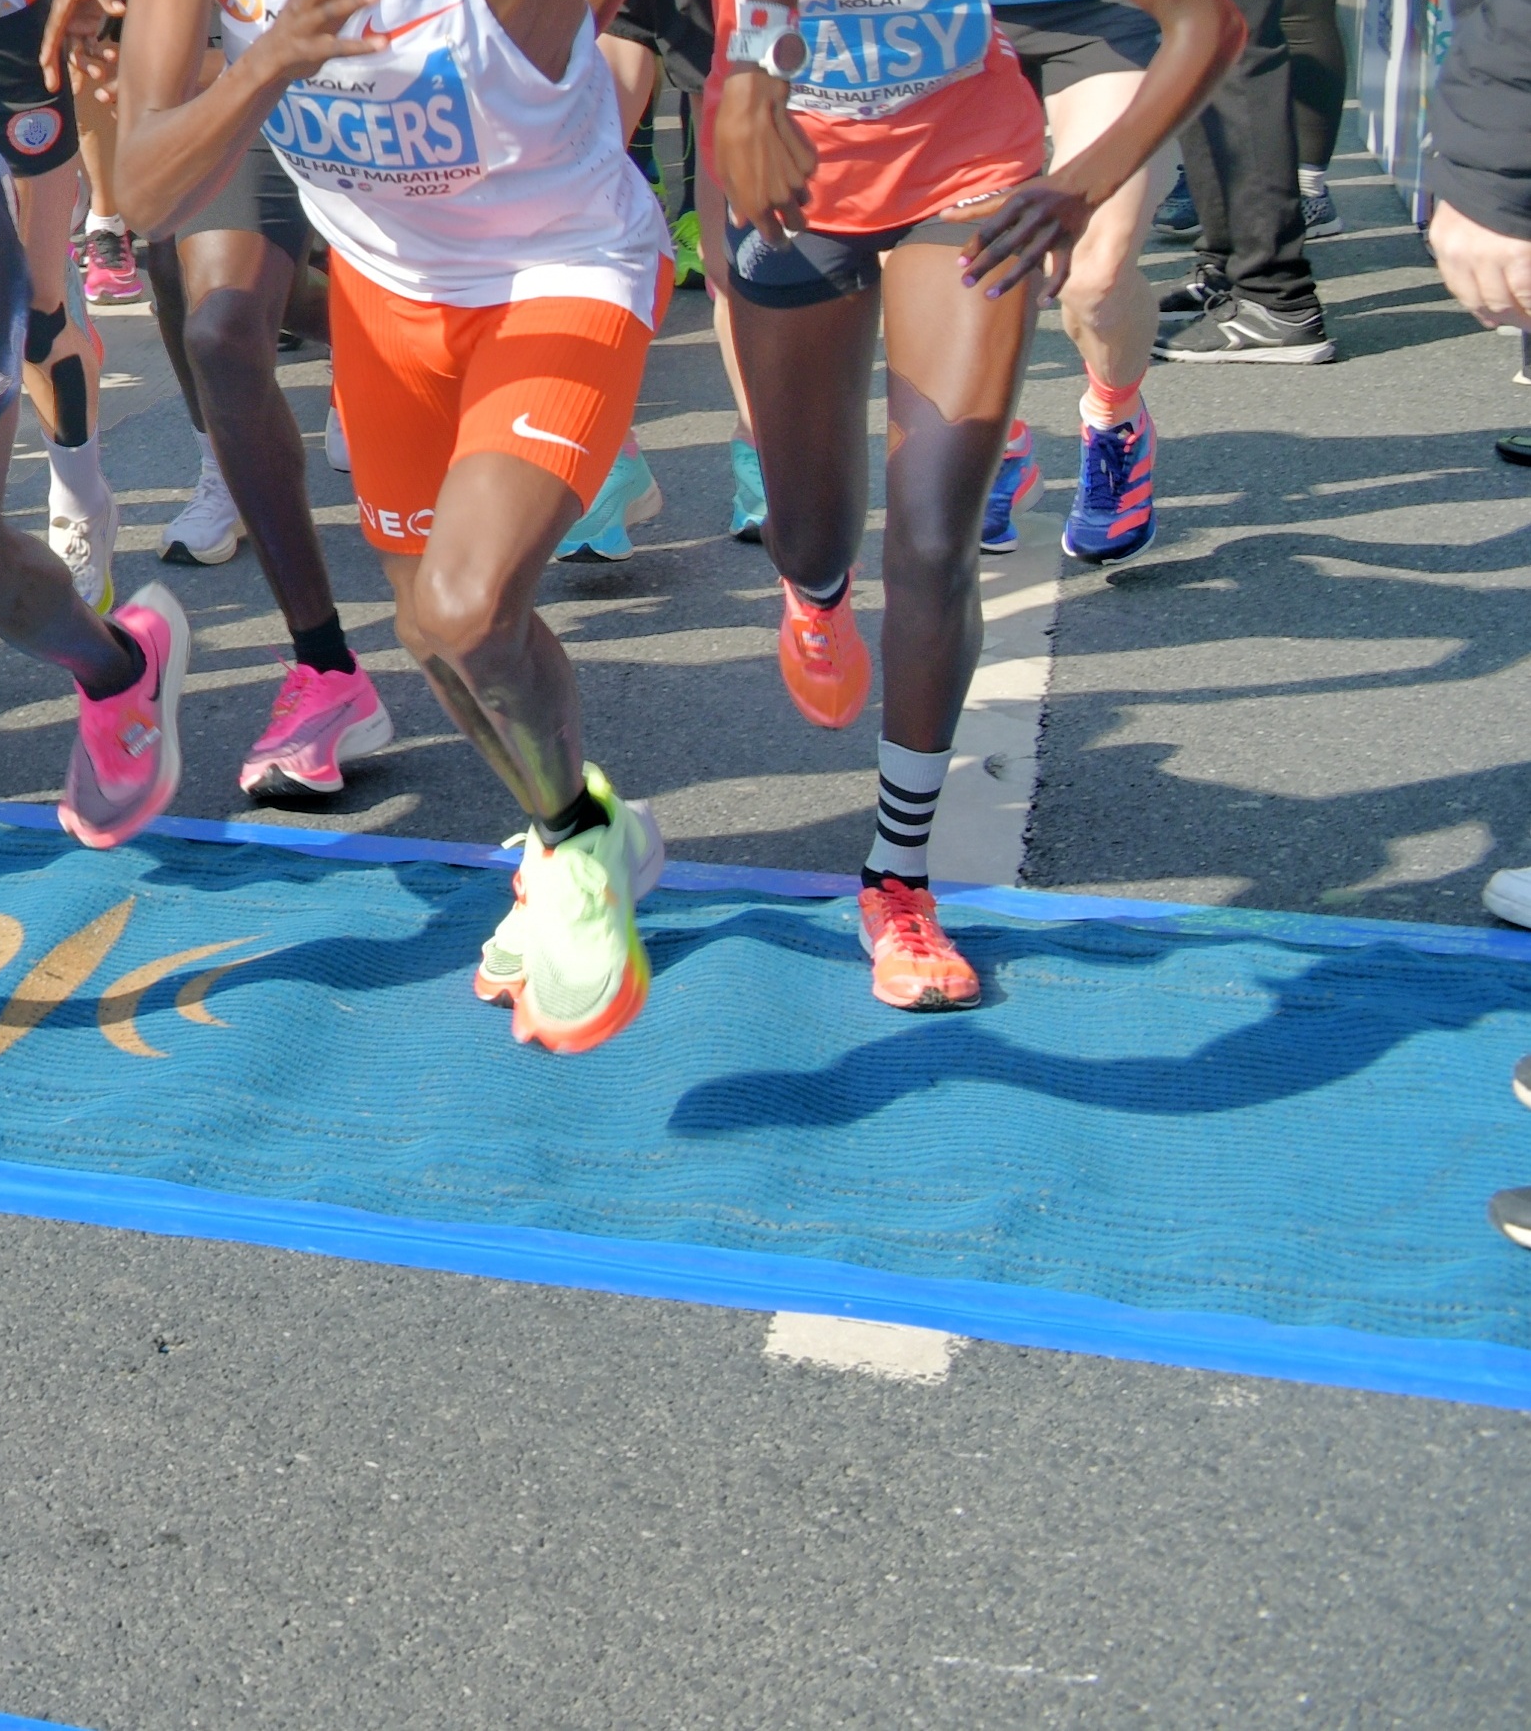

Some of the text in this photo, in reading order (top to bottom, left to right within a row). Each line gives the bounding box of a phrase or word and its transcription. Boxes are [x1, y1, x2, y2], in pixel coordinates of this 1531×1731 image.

[808, 2, 968, 84] AISY
[305, 77, 377, 94] KOLAY
[431, 74, 445, 89] 2
[834, 91, 880, 104] HALF
[262, 94, 464, 168] ODGERS
[312, 161, 482, 186] HALF MARATHON
[404, 183, 452, 198] 2022
